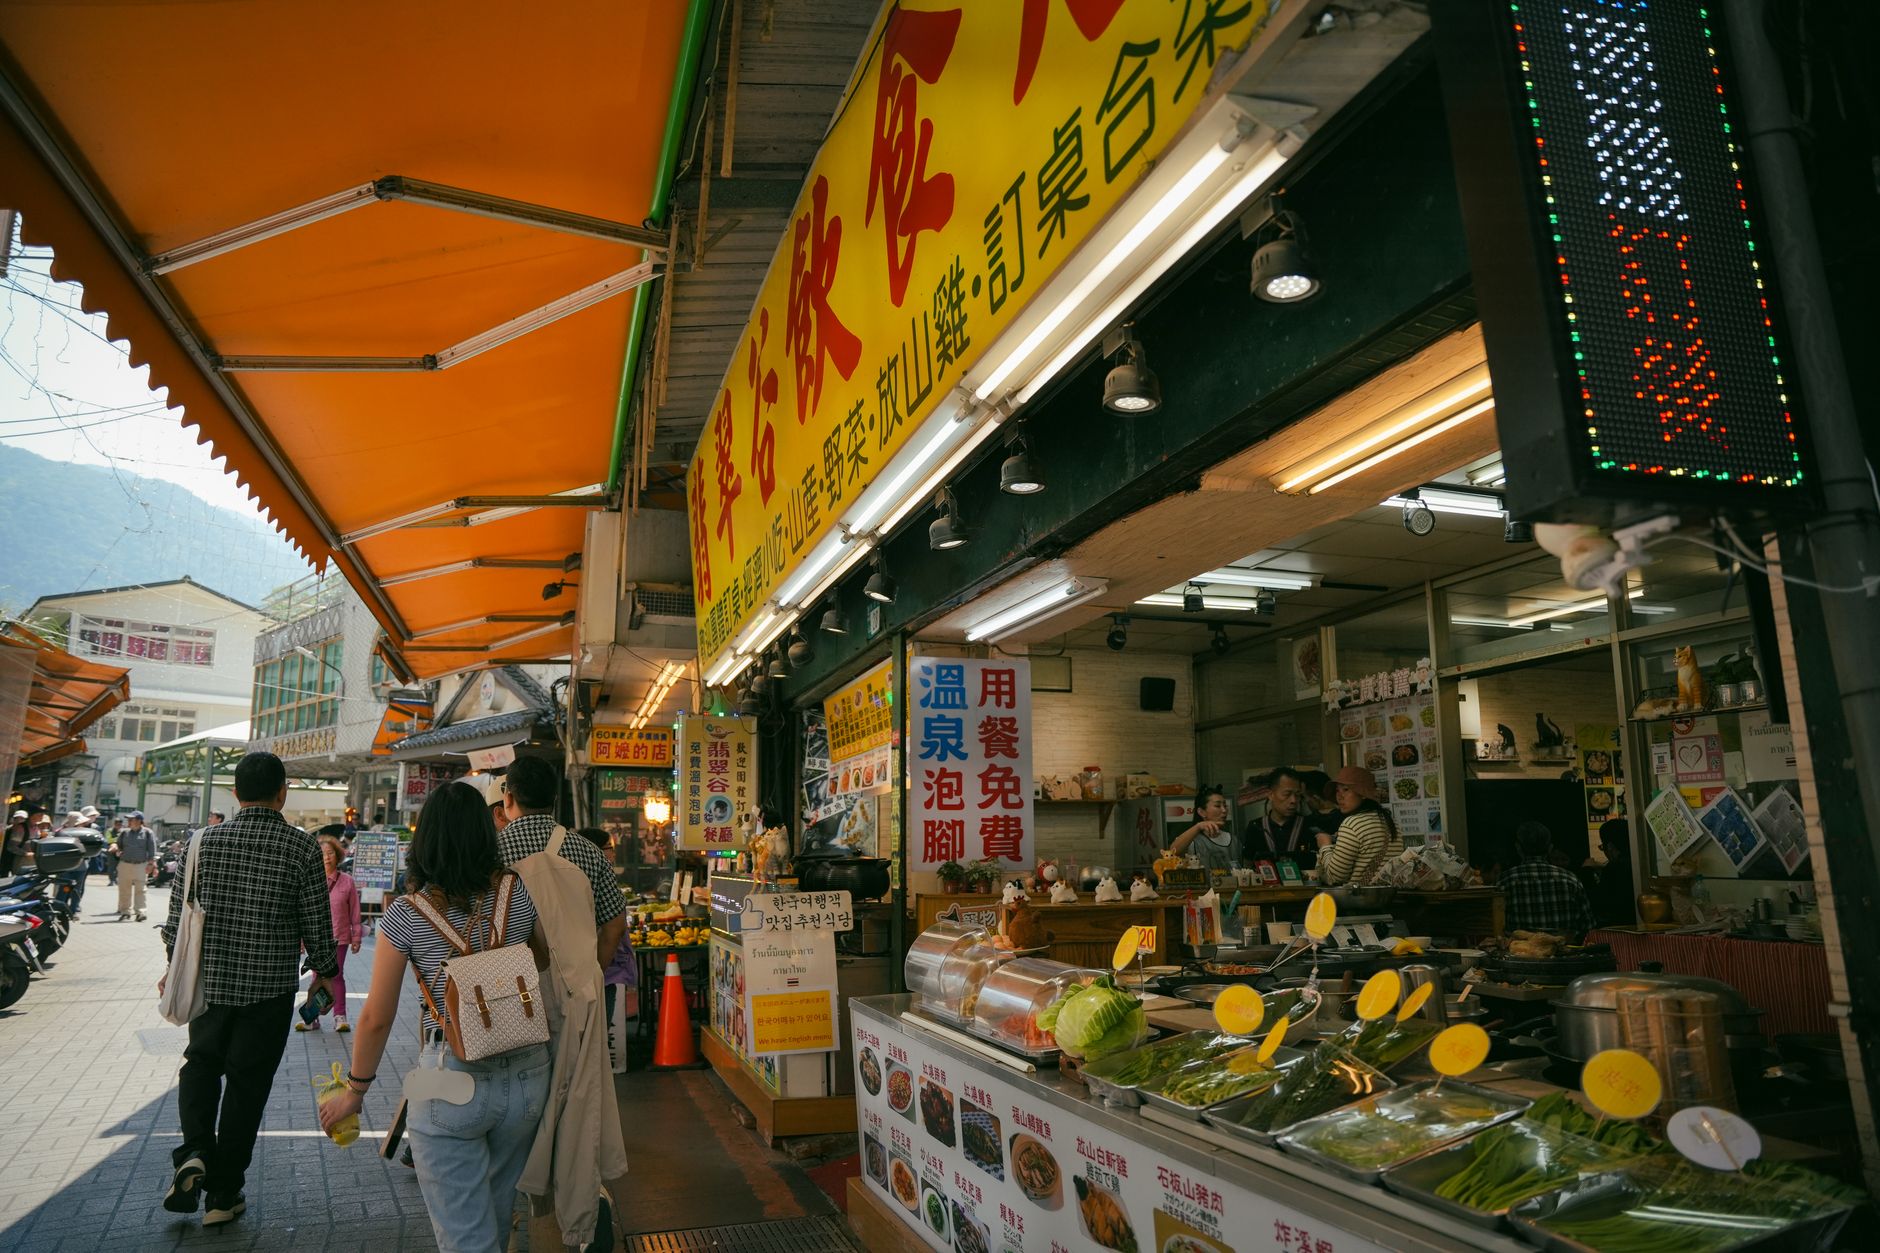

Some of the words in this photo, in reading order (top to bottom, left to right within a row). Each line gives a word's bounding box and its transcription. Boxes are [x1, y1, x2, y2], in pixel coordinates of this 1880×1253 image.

[692, 0, 1125, 608] 翡翠谷飲食
[688, 741, 701, 826] 免費溫泉泡腳
[706, 741, 731, 793] 翡翠谷
[918, 664, 968, 863] 溫泉泡腳
[977, 667, 1025, 863] 用餐免費
[703, 826, 734, 843] 餐廳
[772, 893, 841, 912] 한국여행객
[788, 1035, 811, 1045] English
[1157, 1165, 1224, 1217] 石板山豬肉
